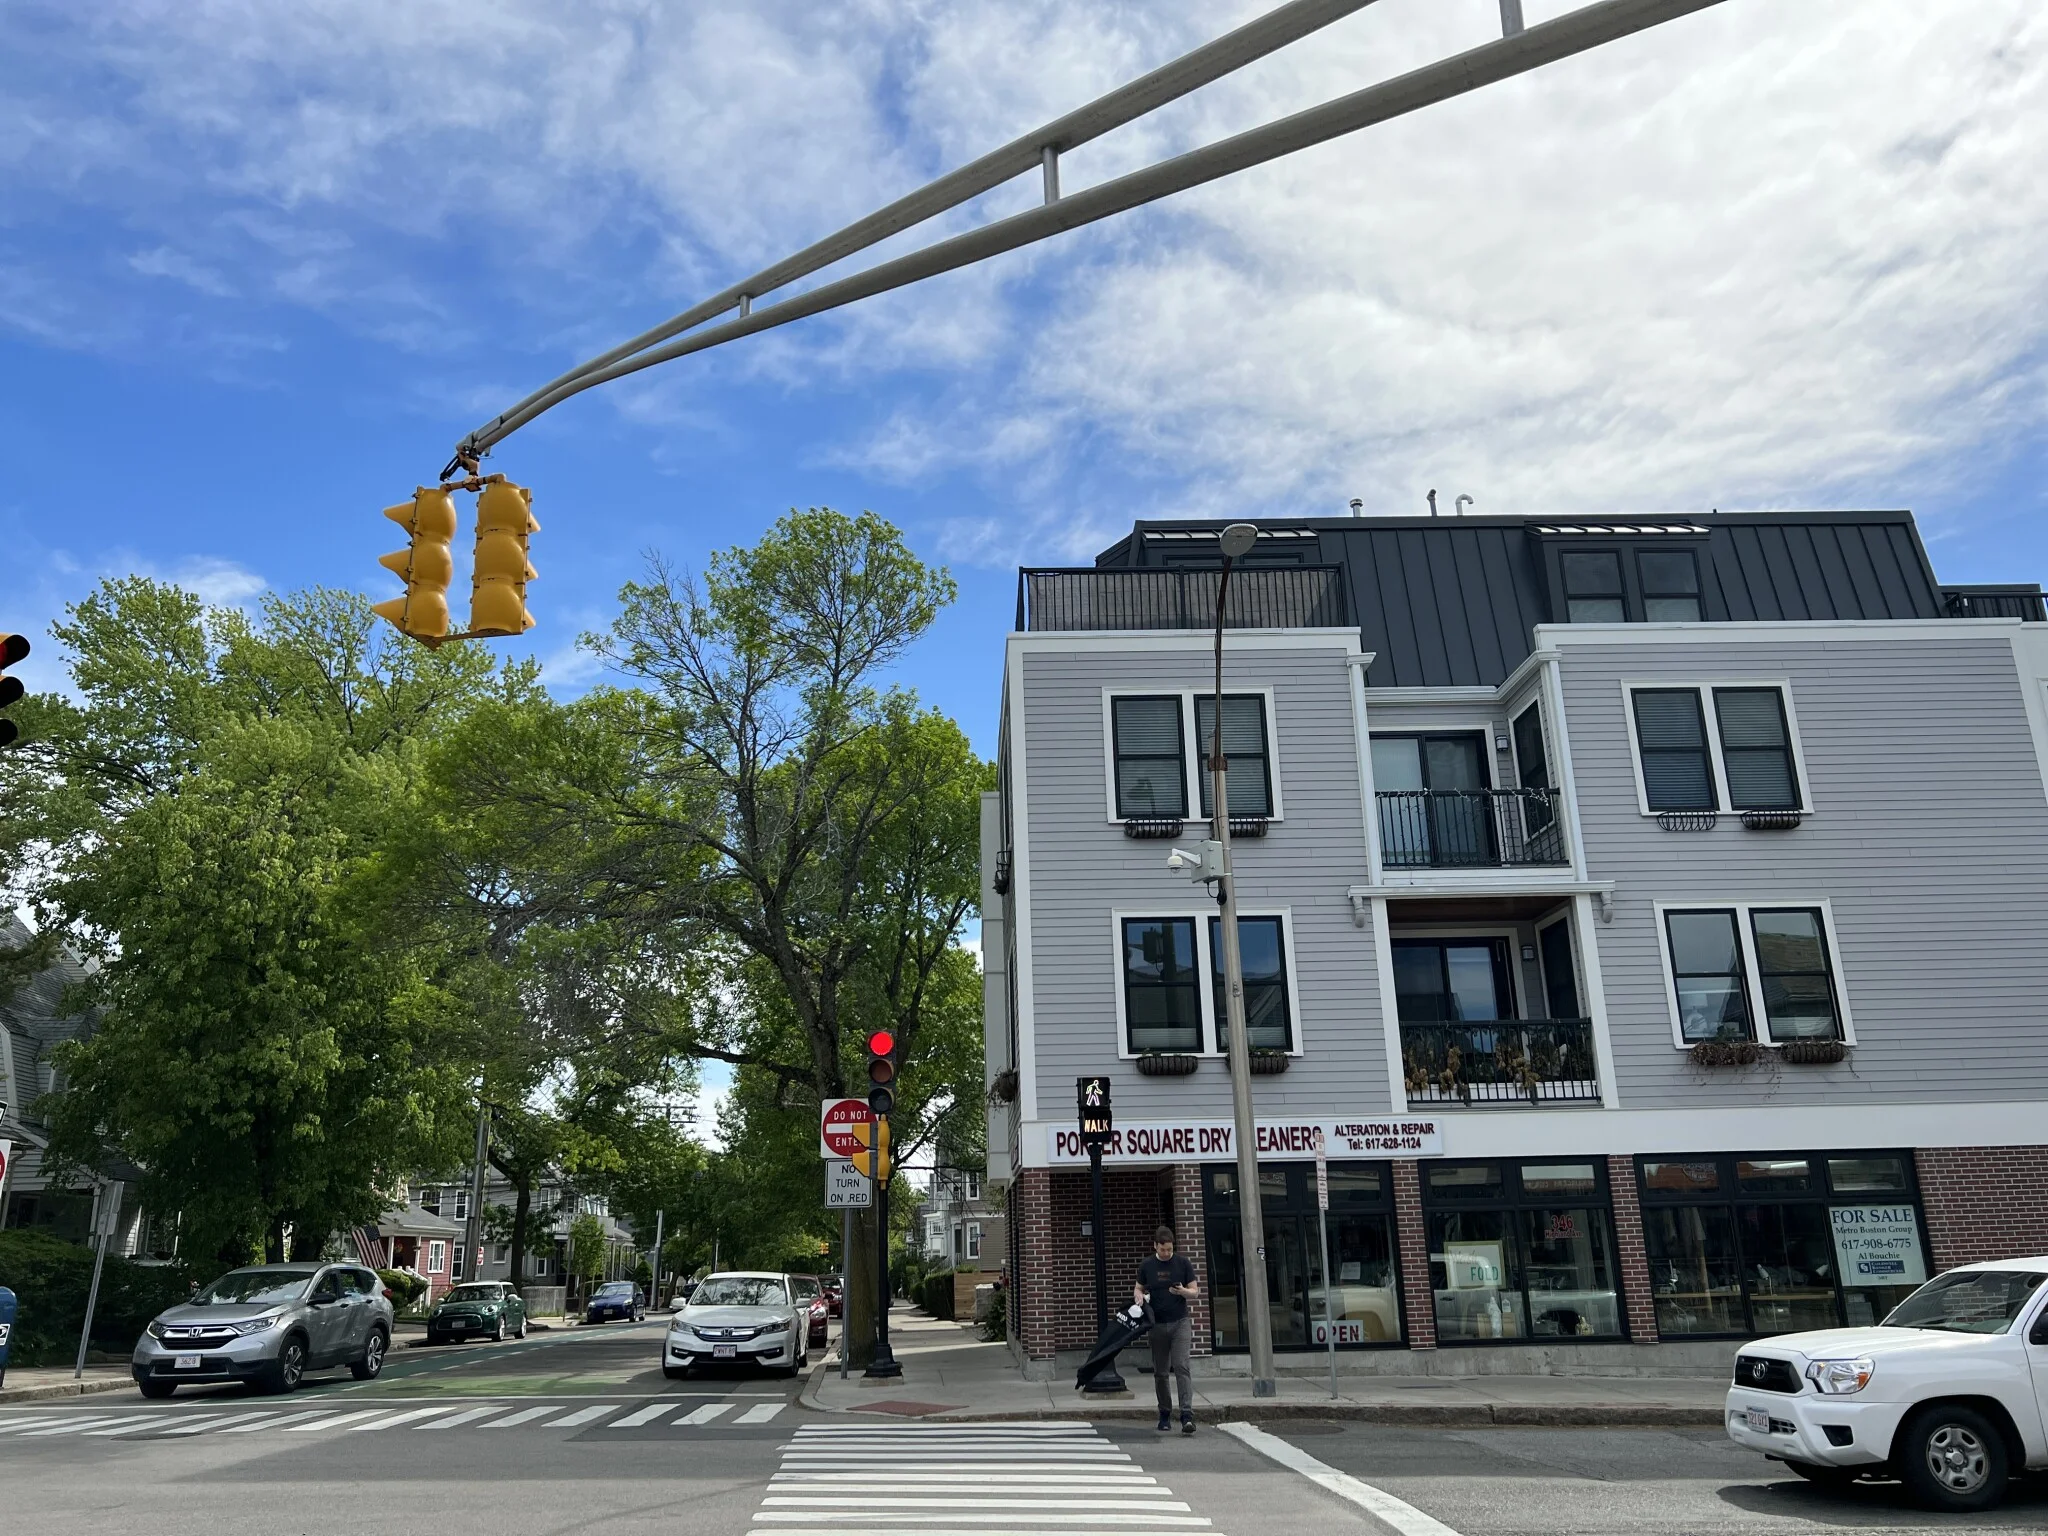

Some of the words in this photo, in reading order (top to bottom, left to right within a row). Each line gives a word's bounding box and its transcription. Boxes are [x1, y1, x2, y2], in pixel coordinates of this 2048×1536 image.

[834, 1111, 846, 1120] DO
[850, 1110, 867, 1120] NOT
[1084, 1119, 1109, 1132] WALK
[1334, 1124, 1390, 1136] ALTERATION
[1392, 1123, 1399, 1135] &
[1401, 1123, 1435, 1135] REPAIR
[835, 1137, 862, 1147] ENTE
[1056, 1130, 1124, 1157] PORER
[1127, 1128, 1194, 1155] SQUARE
[1199, 1127, 1232, 1153] DRY
[1347, 1138, 1364, 1150] Tel:
[1365, 1137, 1421, 1150] 617-628-1124
[841, 1164, 856, 1174] NO
[836, 1178, 860, 1188] TURN
[830, 1193, 844, 1203] ON
[849, 1193, 868, 1202] RED
[1831, 1209, 1866, 1223] FOR
[1870, 1208, 1913, 1222] SALE
[1551, 1214, 1574, 1230] 346
[1835, 1226, 1858, 1234] Metro
[1888, 1225, 1913, 1235] Group
[1841, 1238, 1912, 1250] 617-908-6775
[1470, 1266, 1499, 1281] FOLD
